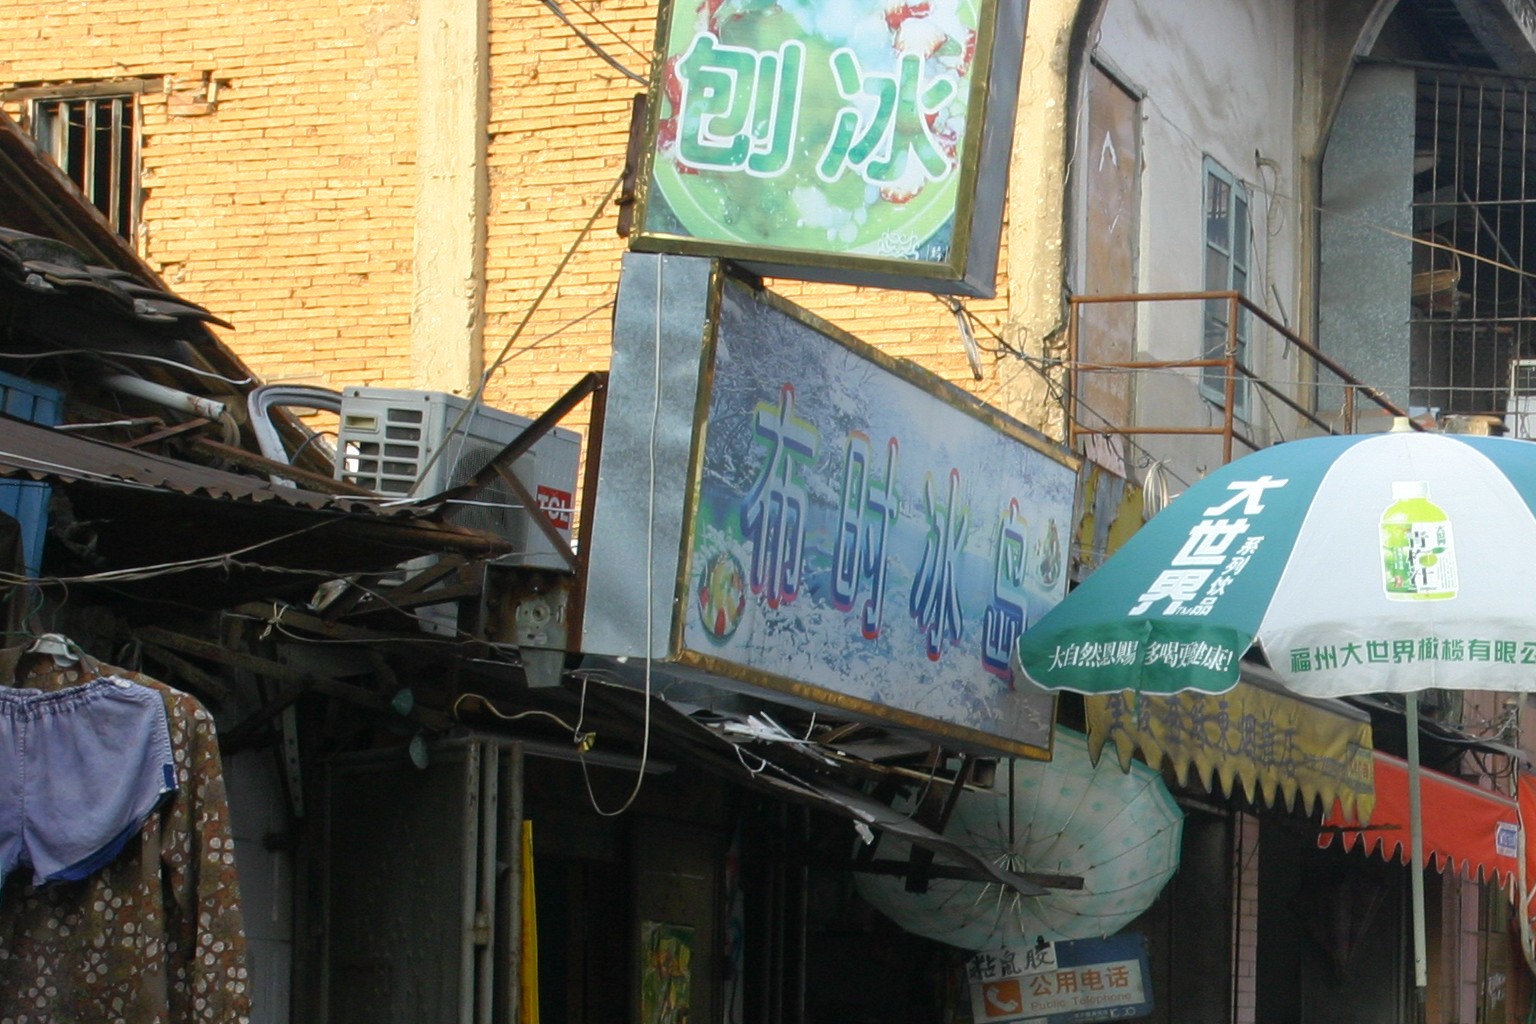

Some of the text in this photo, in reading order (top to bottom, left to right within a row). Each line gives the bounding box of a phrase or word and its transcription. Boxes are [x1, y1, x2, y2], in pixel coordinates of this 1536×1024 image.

[675, 32, 960, 184] 刨冰
[538, 493, 569, 525] TCL
[738, 382, 1030, 692] 布时冰岛
[1127, 475, 1290, 617] 大世界
[1187, 535, 1265, 616] 系列饮品
[1029, 965, 1130, 997] 公用电话
[1031, 992, 1133, 1011] Public Telephone
